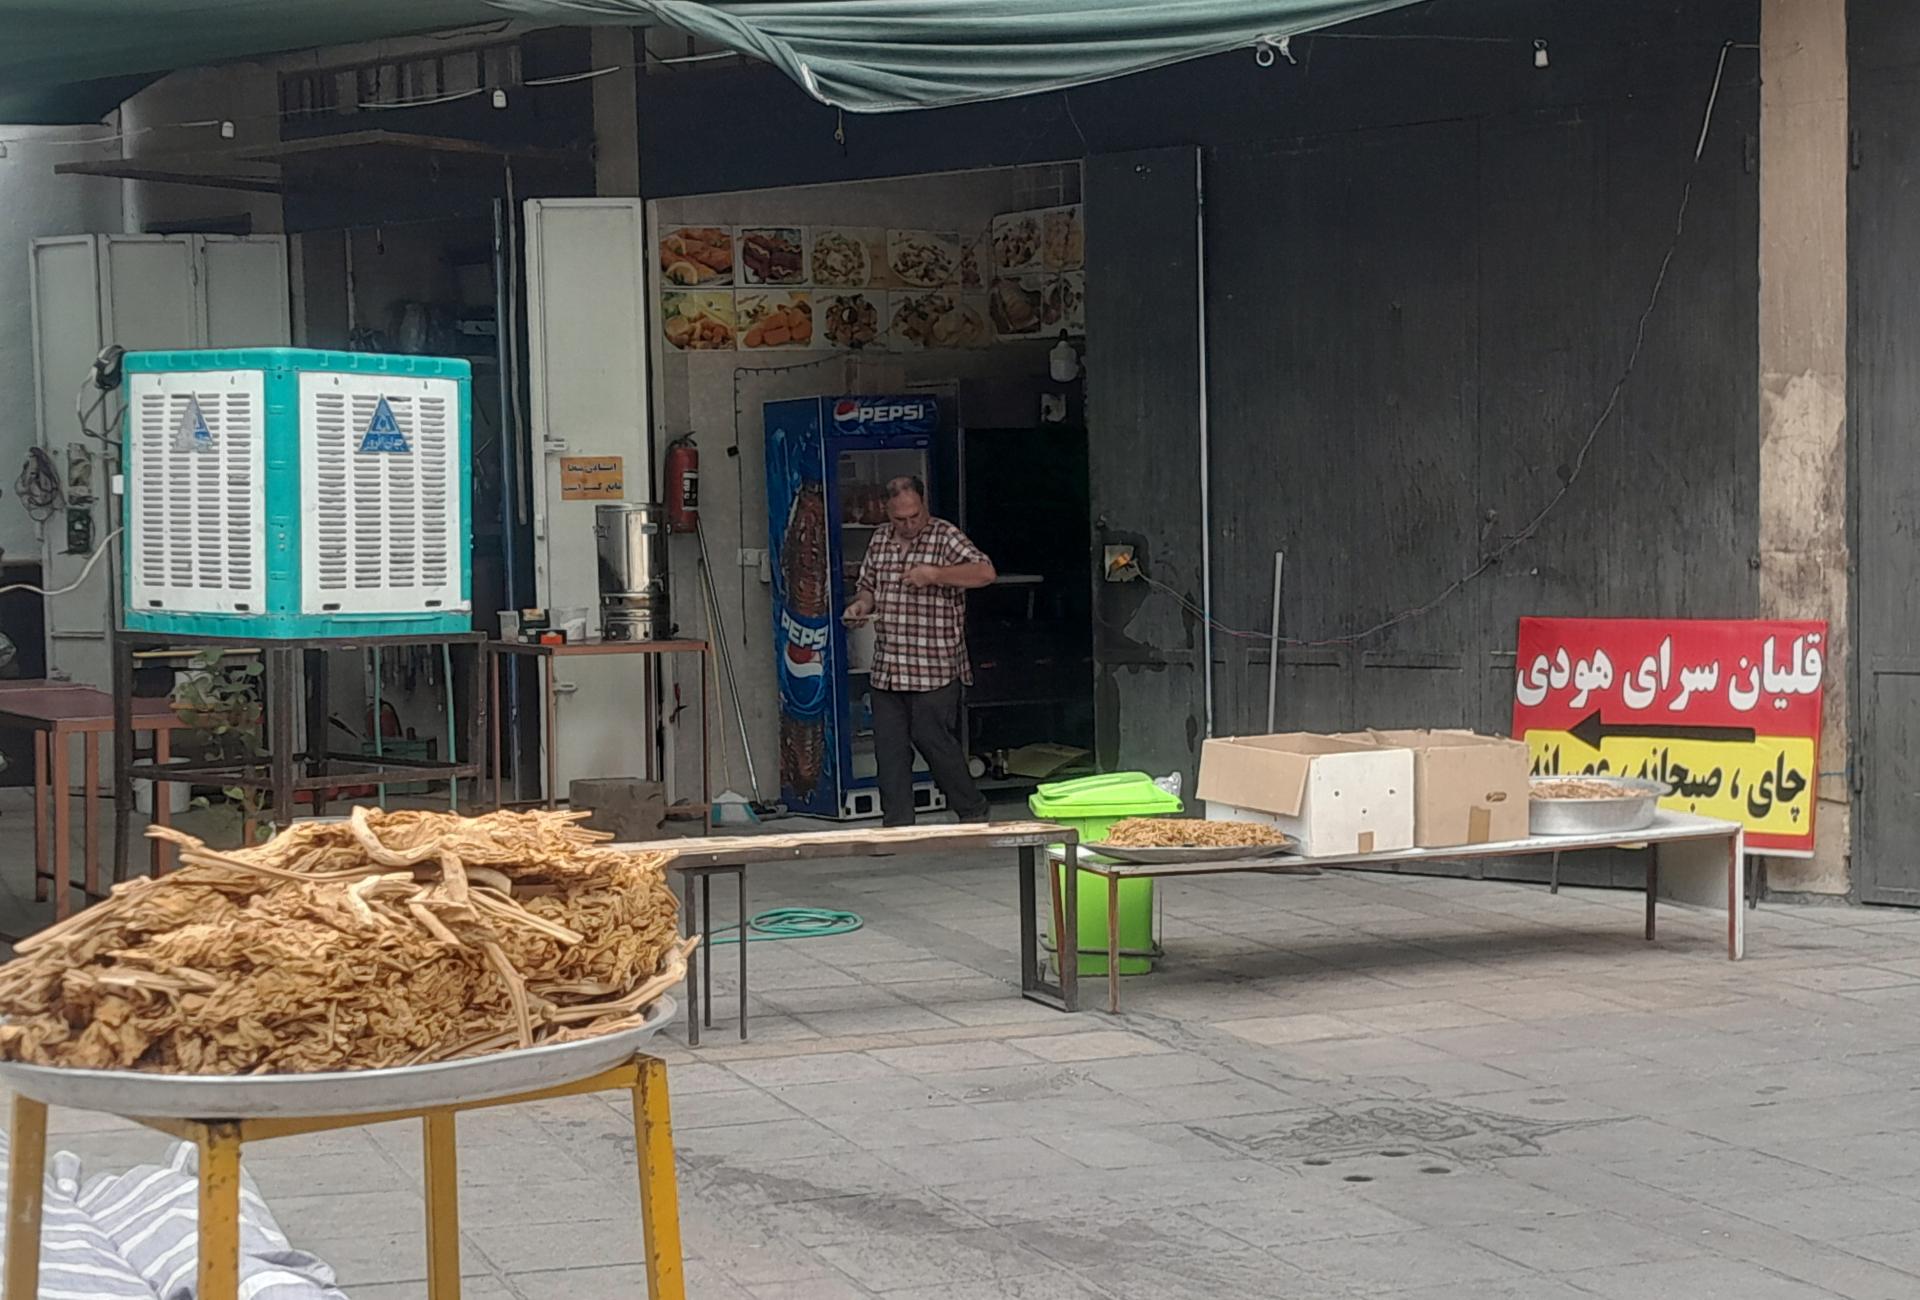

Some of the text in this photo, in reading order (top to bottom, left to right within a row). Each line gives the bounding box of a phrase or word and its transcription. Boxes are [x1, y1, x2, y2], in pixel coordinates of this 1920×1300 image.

[859, 404, 924, 423] PEPSI
[781, 608, 829, 650] PEPSI
[1516, 632, 1823, 711] قلیان سرای هودی
[1748, 750, 1807, 823] چای
